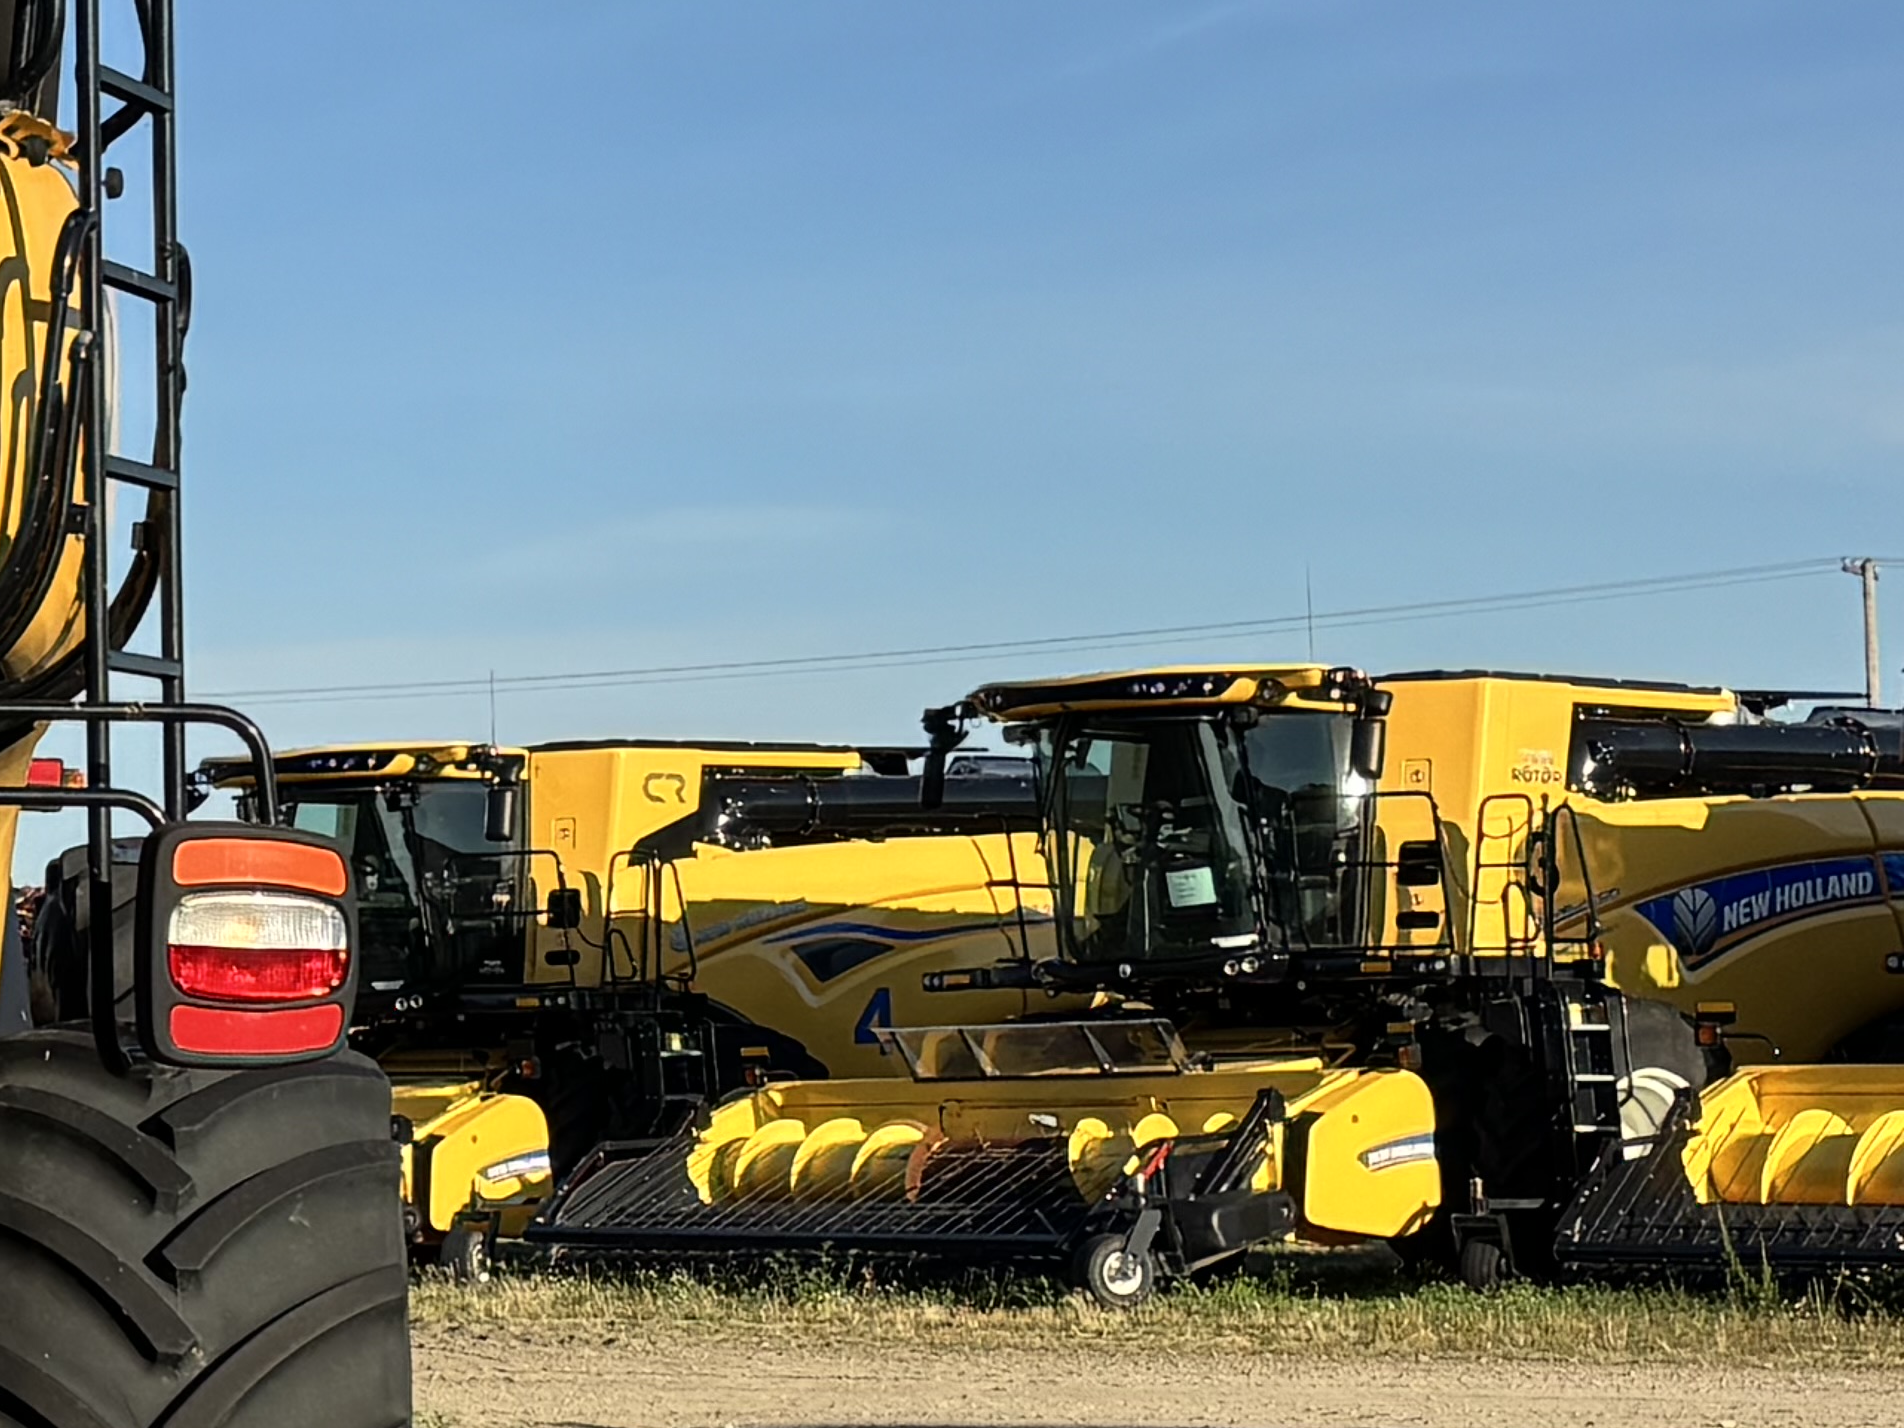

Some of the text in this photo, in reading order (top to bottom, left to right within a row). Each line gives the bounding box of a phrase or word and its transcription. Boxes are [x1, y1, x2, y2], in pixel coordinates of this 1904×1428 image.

[642, 772, 686, 804] CR
[1722, 871, 1874, 932] NEW HOLLAND
